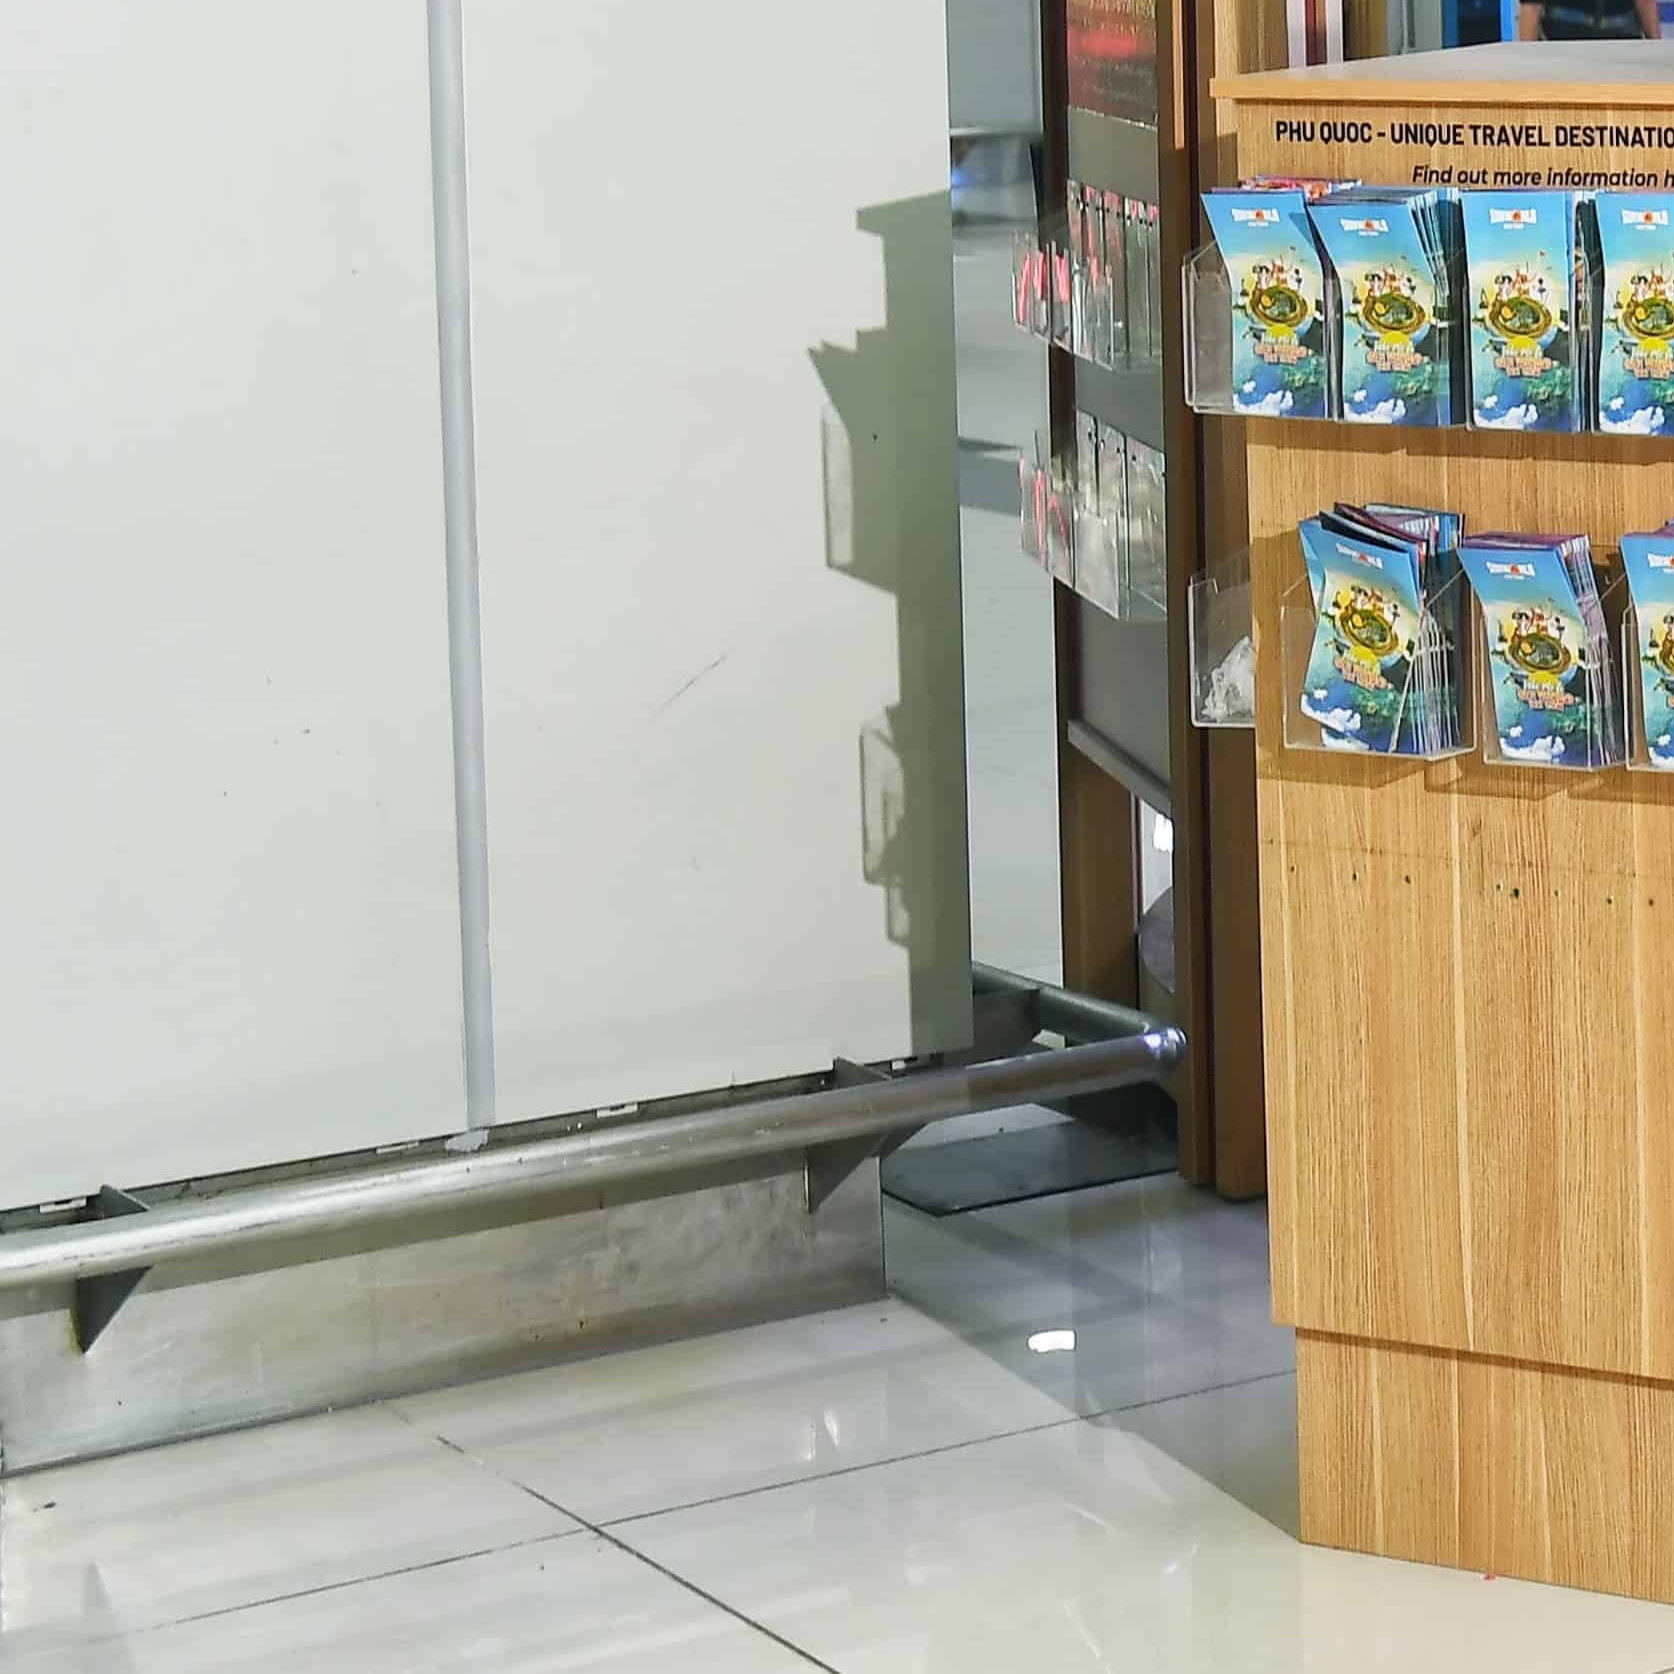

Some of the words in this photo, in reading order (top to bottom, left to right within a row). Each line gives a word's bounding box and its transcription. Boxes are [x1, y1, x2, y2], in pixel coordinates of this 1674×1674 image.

[1275, 121, 1314, 143] PHU
[1319, 122, 1372, 145] QUOC
[1391, 123, 1464, 147] UNIQUE
[1468, 124, 1550, 147] TRAVEL
[1412, 165, 1453, 184] Find
[1457, 168, 1488, 185] out
[1493, 171, 1542, 187] more
[1546, 167, 1658, 188] information
